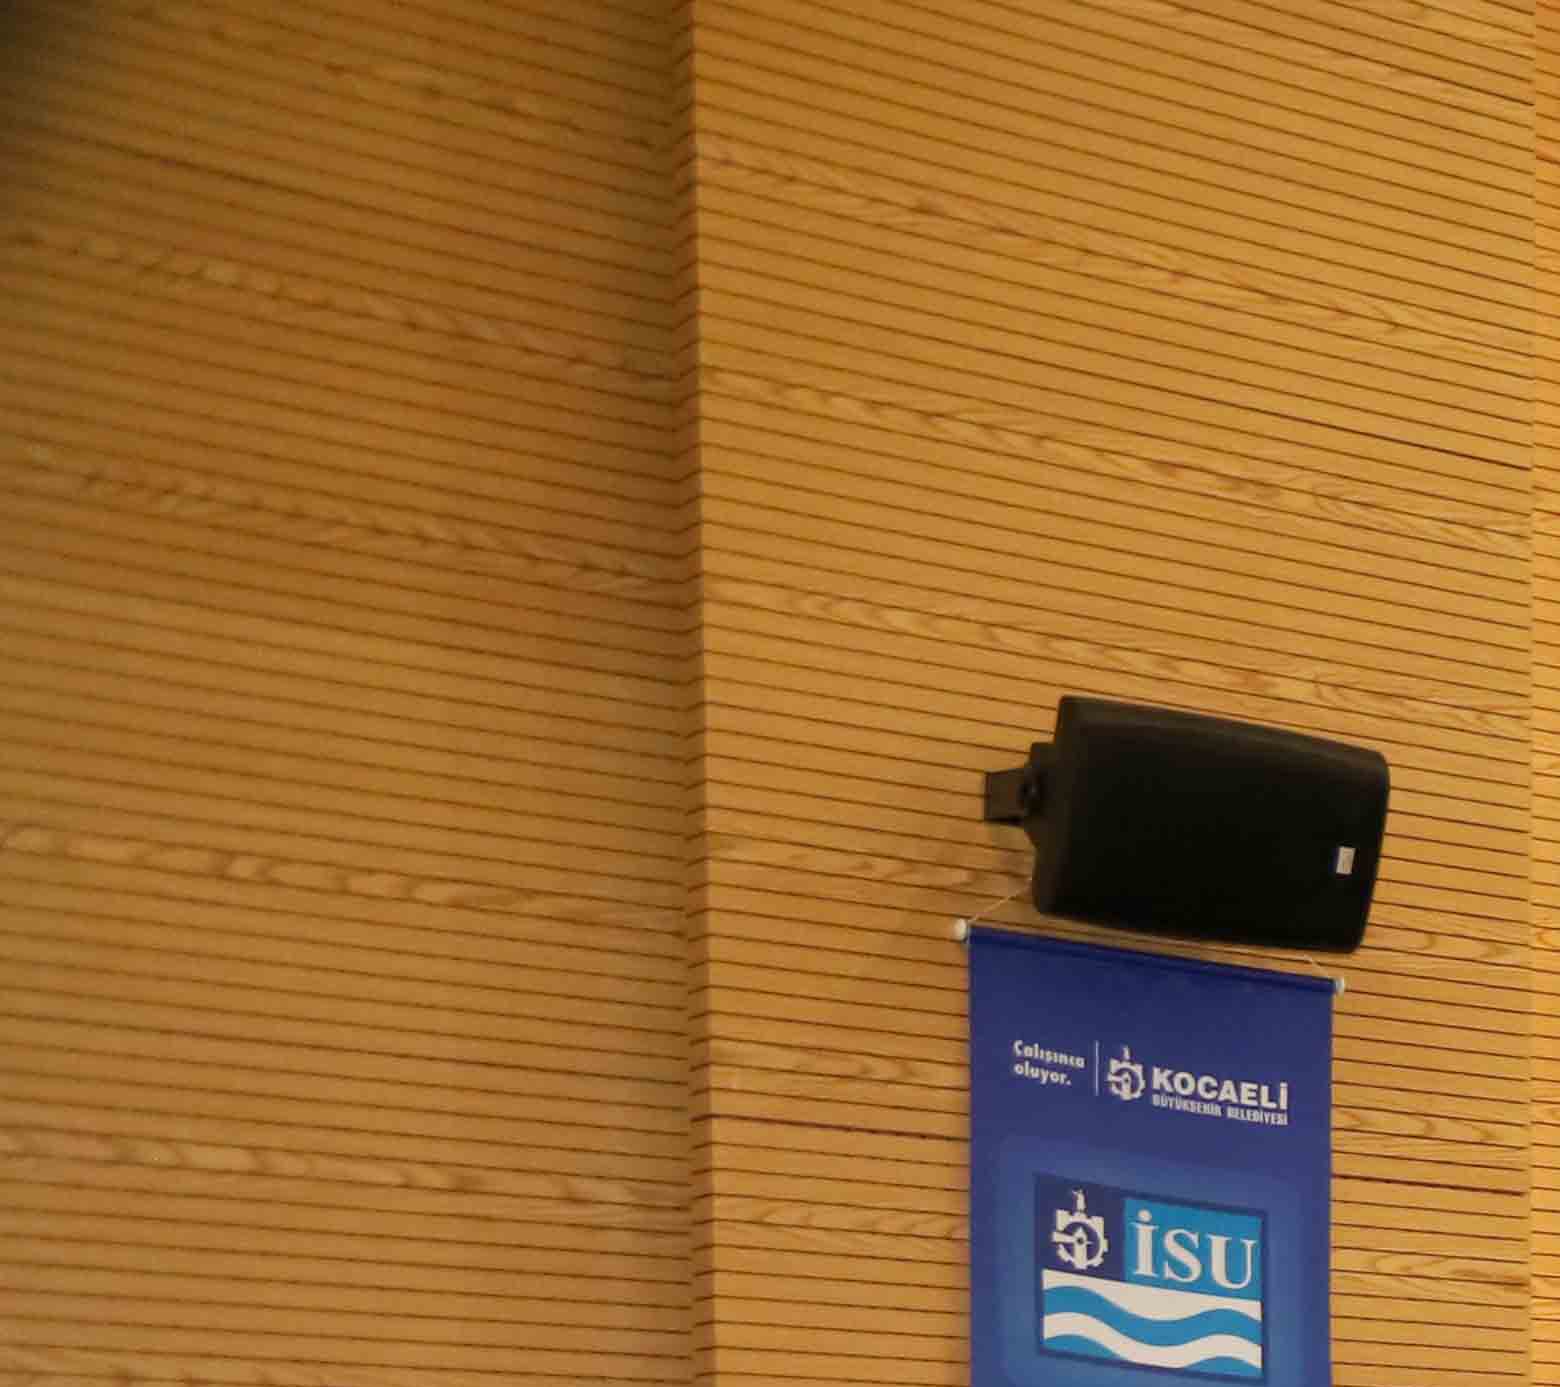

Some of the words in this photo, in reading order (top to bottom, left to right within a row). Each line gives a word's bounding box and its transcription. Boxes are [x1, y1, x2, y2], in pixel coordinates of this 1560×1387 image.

[1013, 1060, 1072, 1085] oluyor.
[1152, 1066, 1288, 1110] KOCAELİ
[1131, 1210, 1256, 1289] İSU
